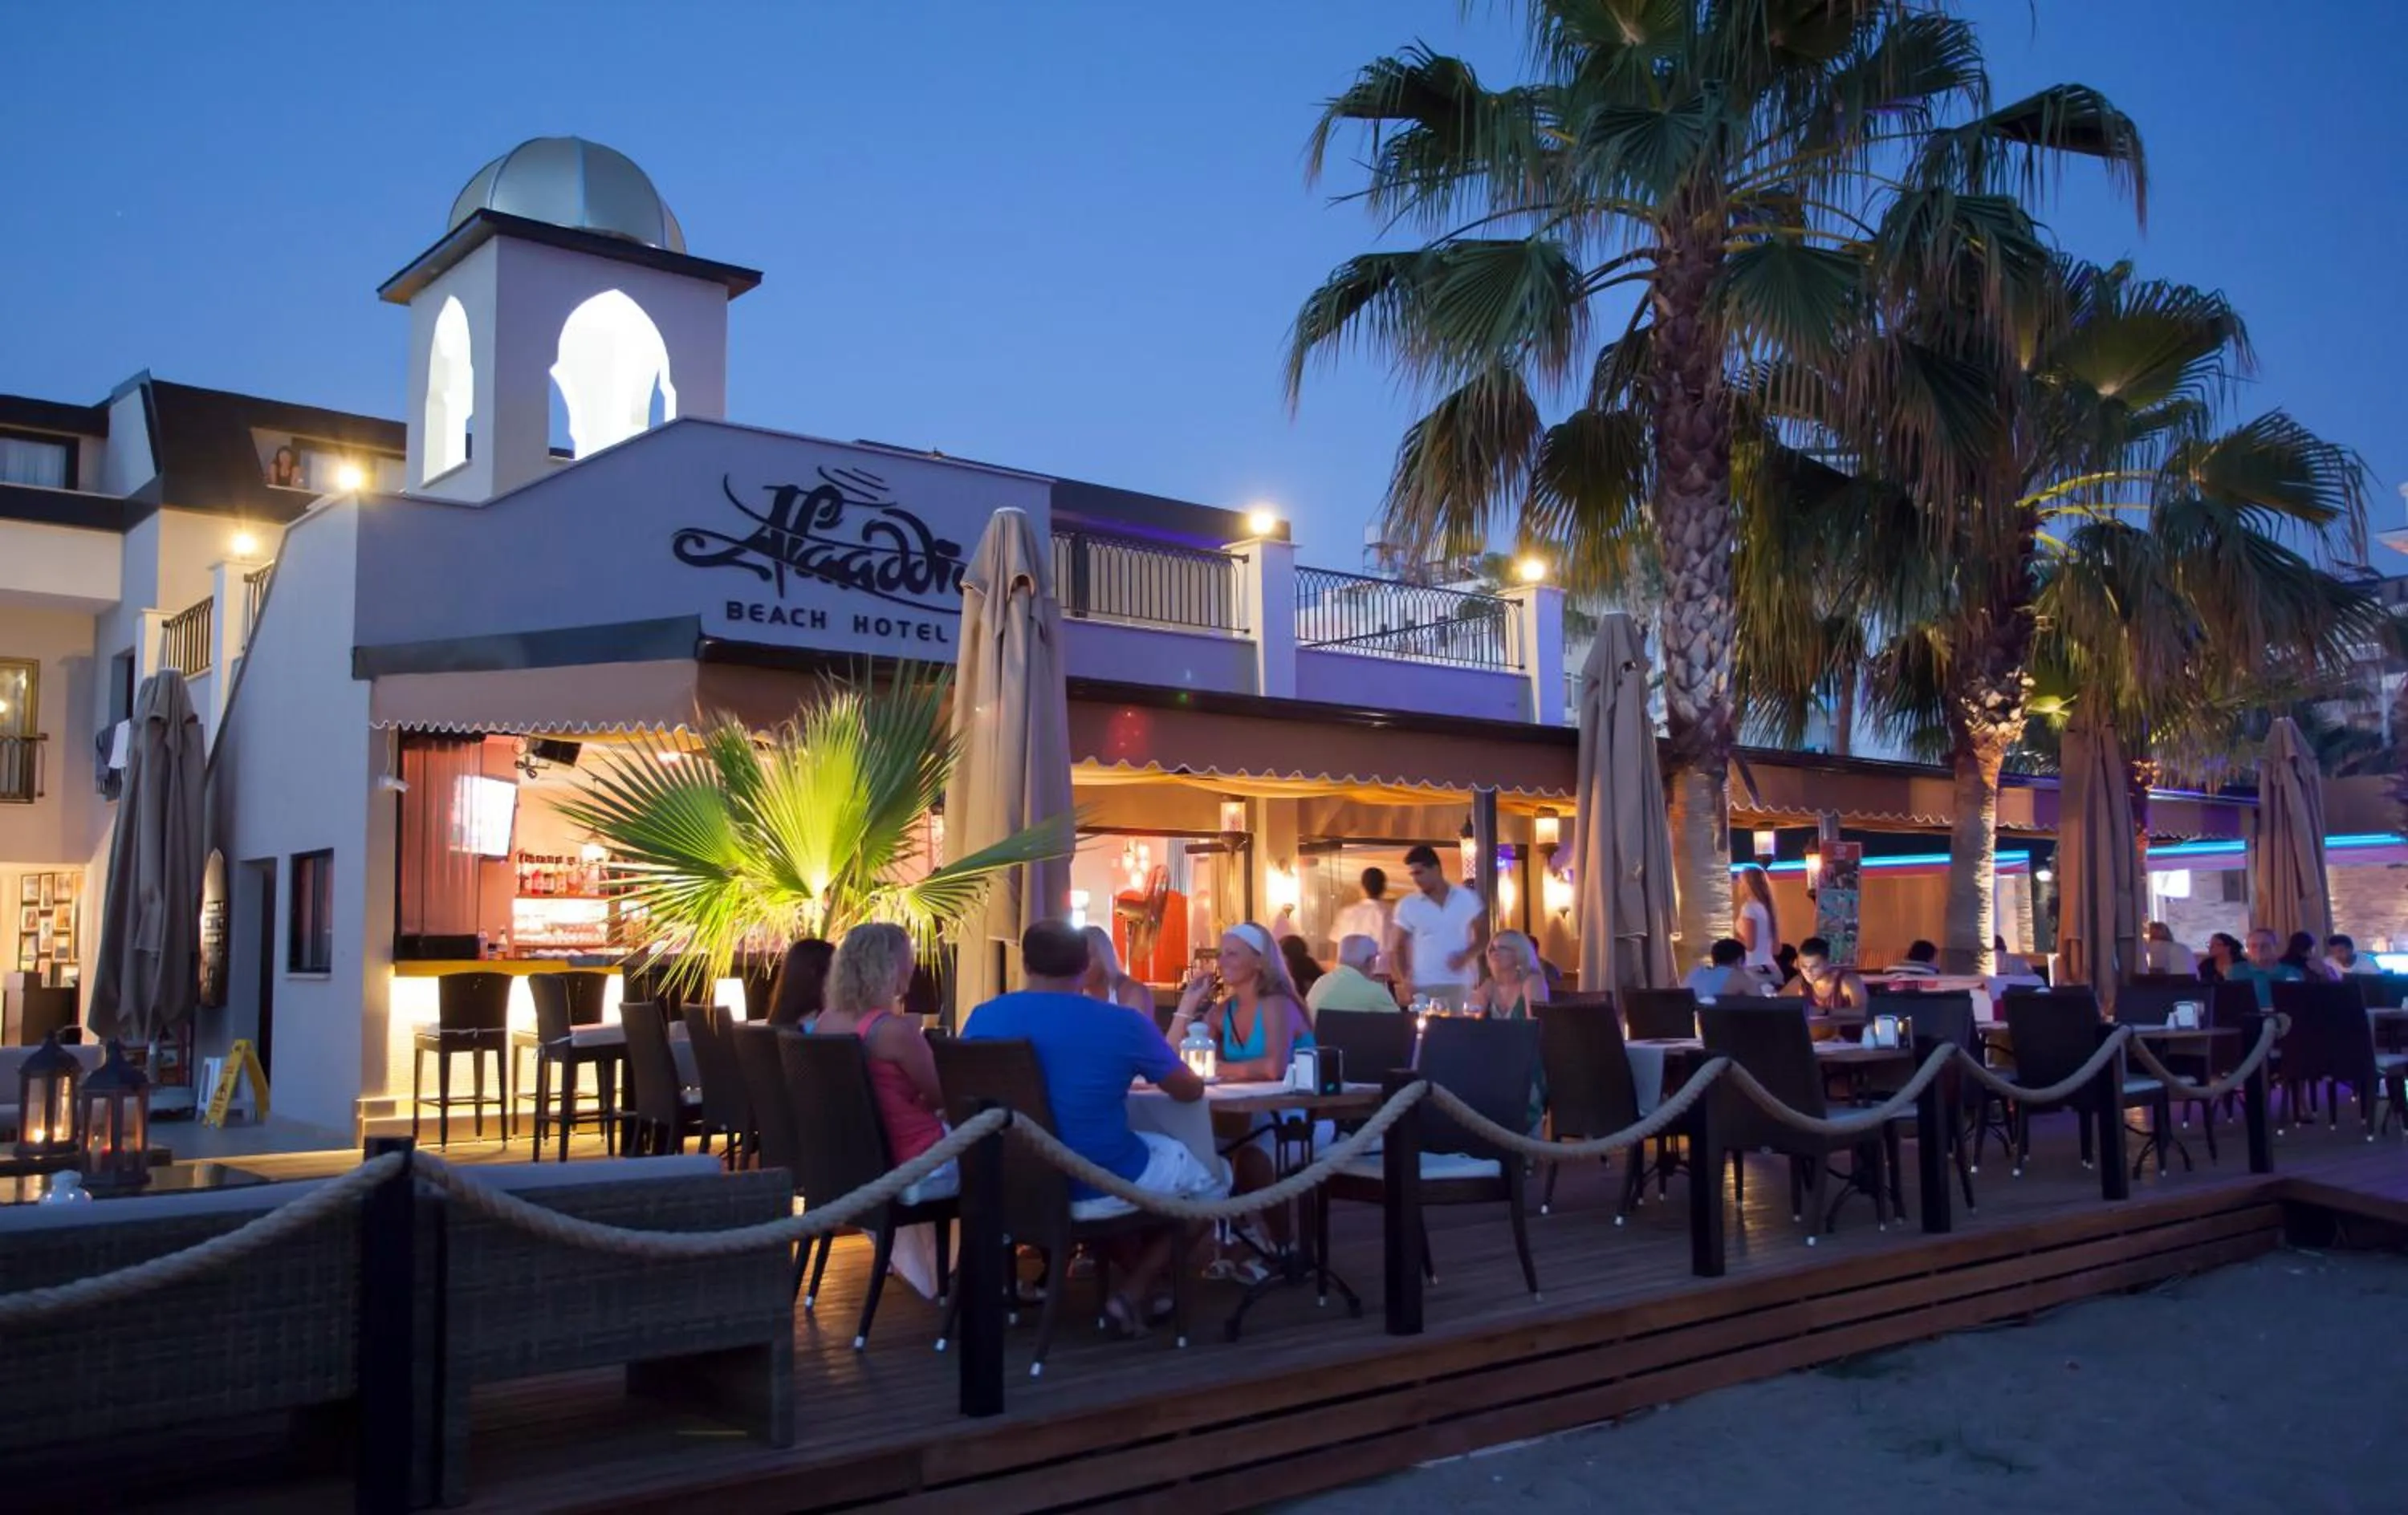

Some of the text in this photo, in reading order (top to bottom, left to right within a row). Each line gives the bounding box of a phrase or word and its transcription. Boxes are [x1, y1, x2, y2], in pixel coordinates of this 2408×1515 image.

[673, 474, 967, 606] Alaaddi
[726, 600, 949, 644] BEACH HOTEL
